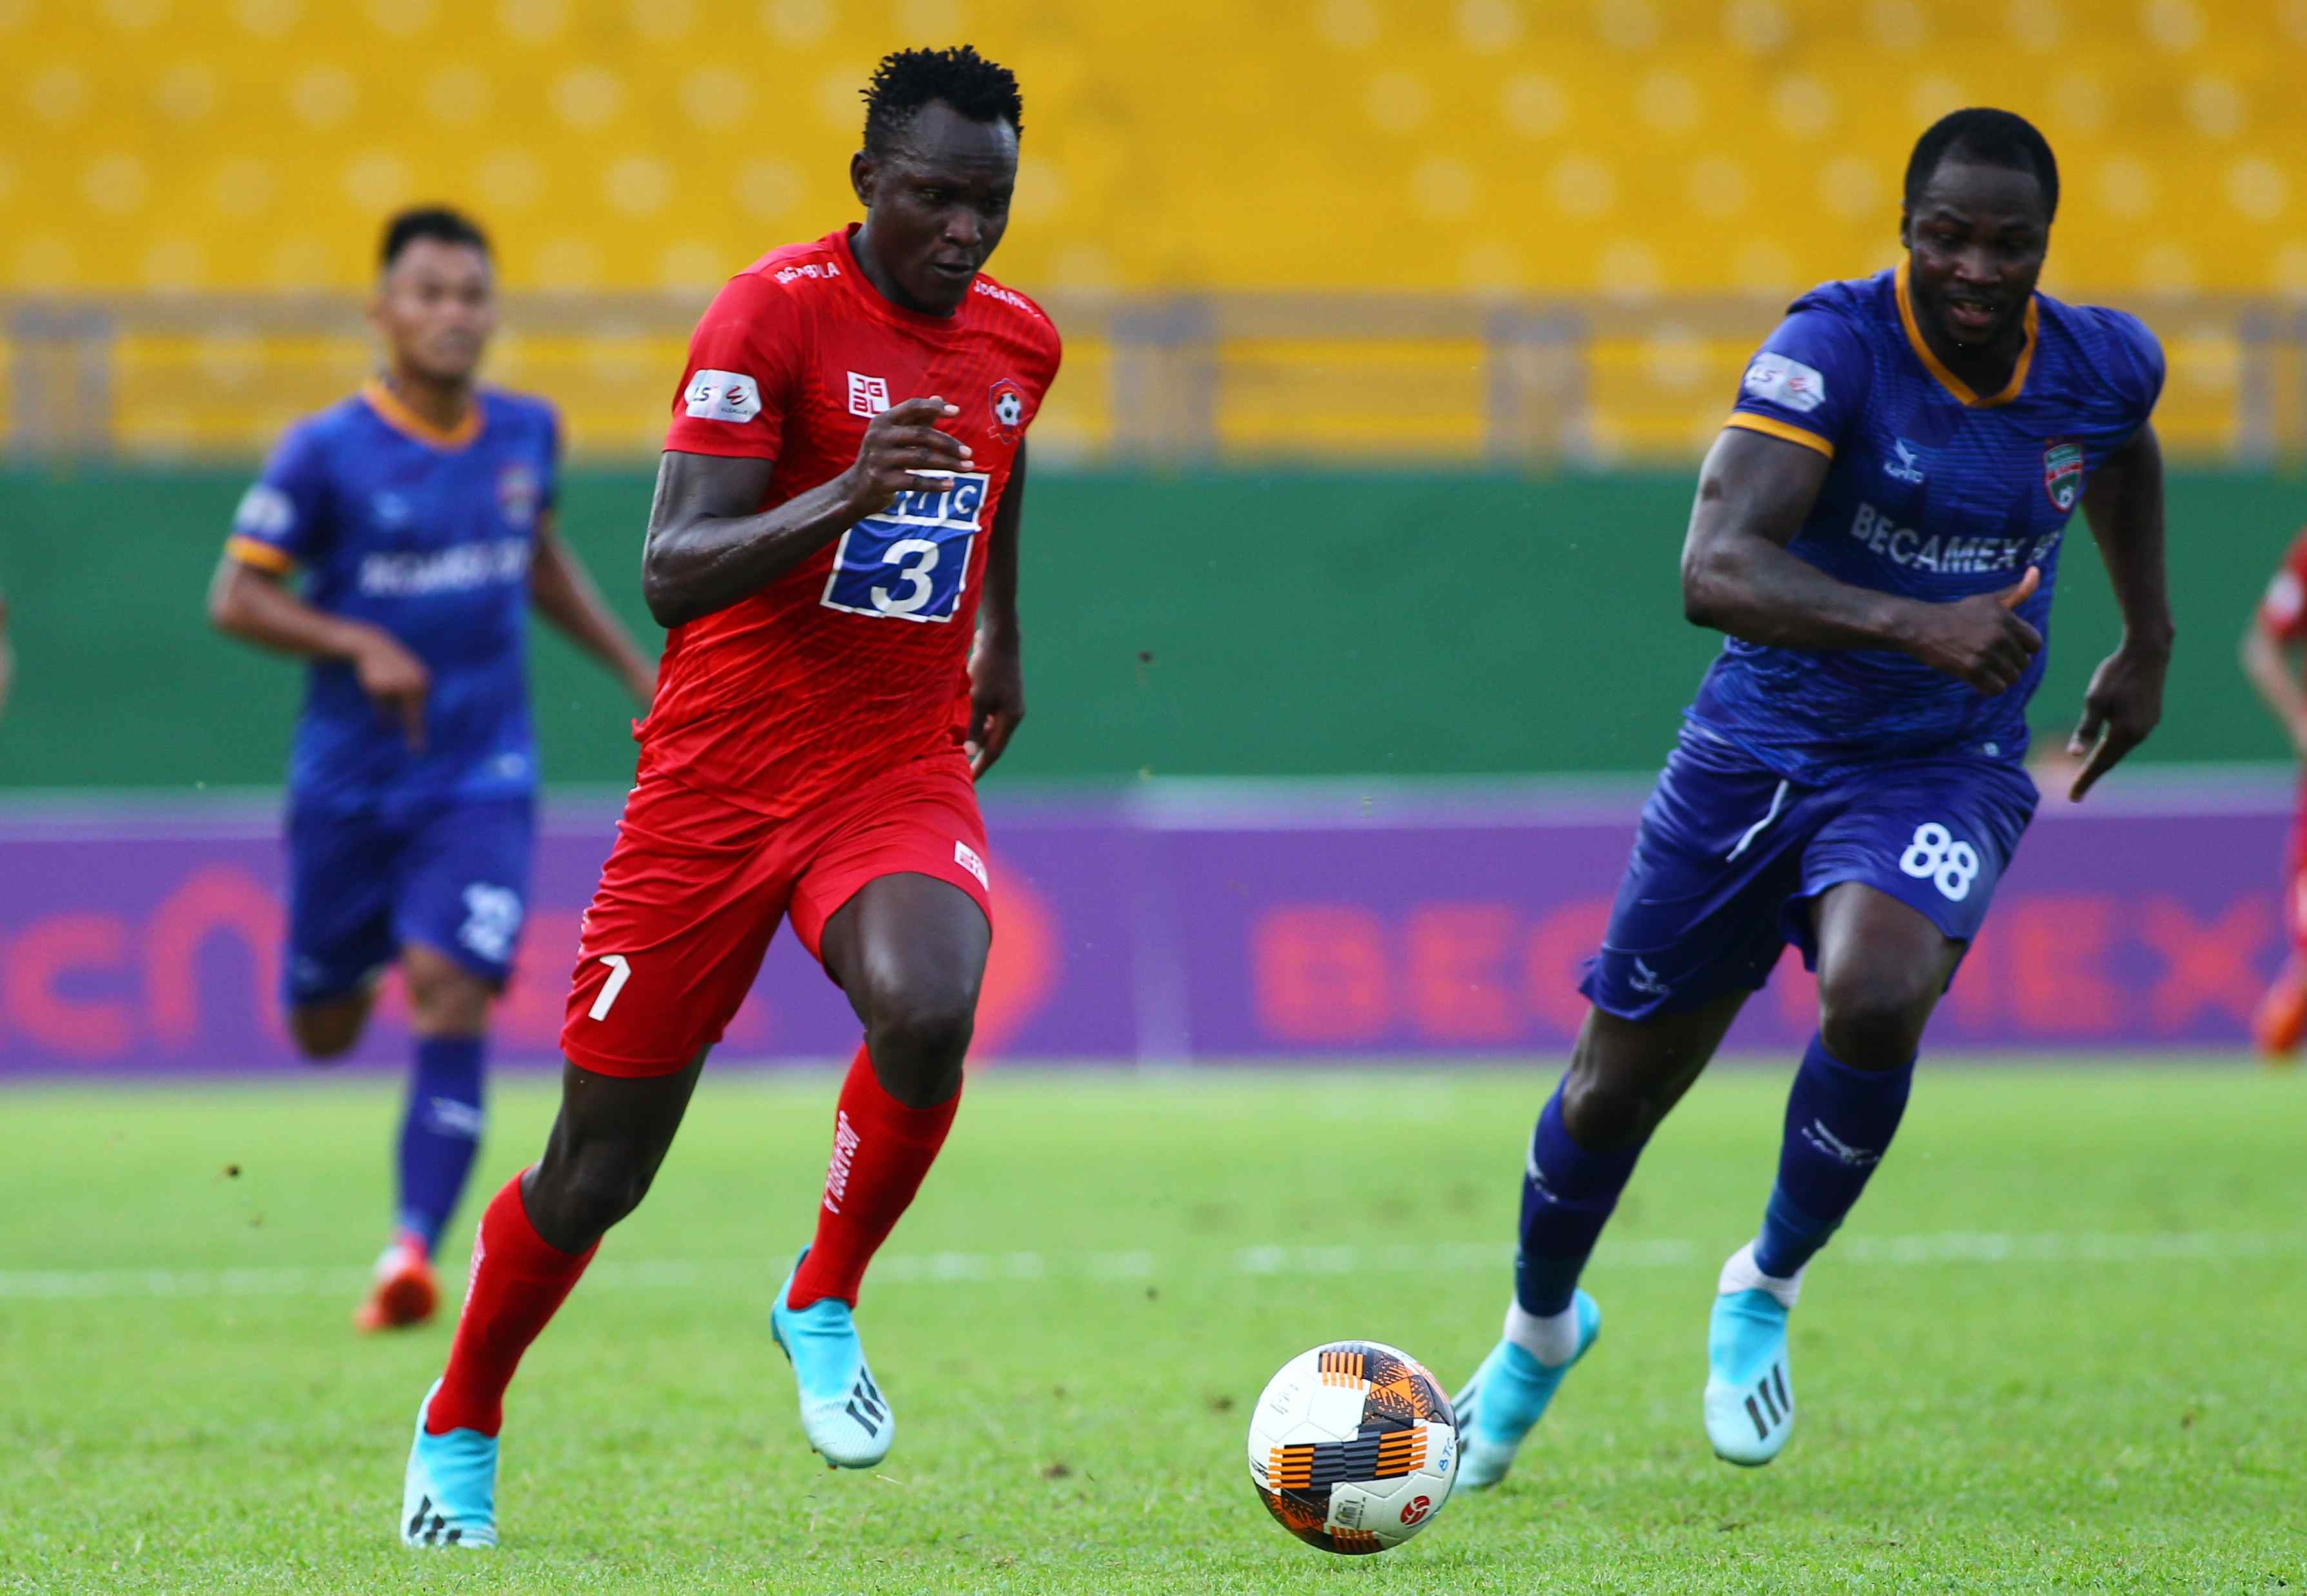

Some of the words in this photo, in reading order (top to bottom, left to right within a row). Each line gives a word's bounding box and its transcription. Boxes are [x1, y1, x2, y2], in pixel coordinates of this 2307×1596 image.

[870, 538, 940, 614] 3
[1850, 502, 2029, 573] BECAMEX
[1899, 822, 1980, 903] 88
[1251, 893, 2267, 1043] BECEX
